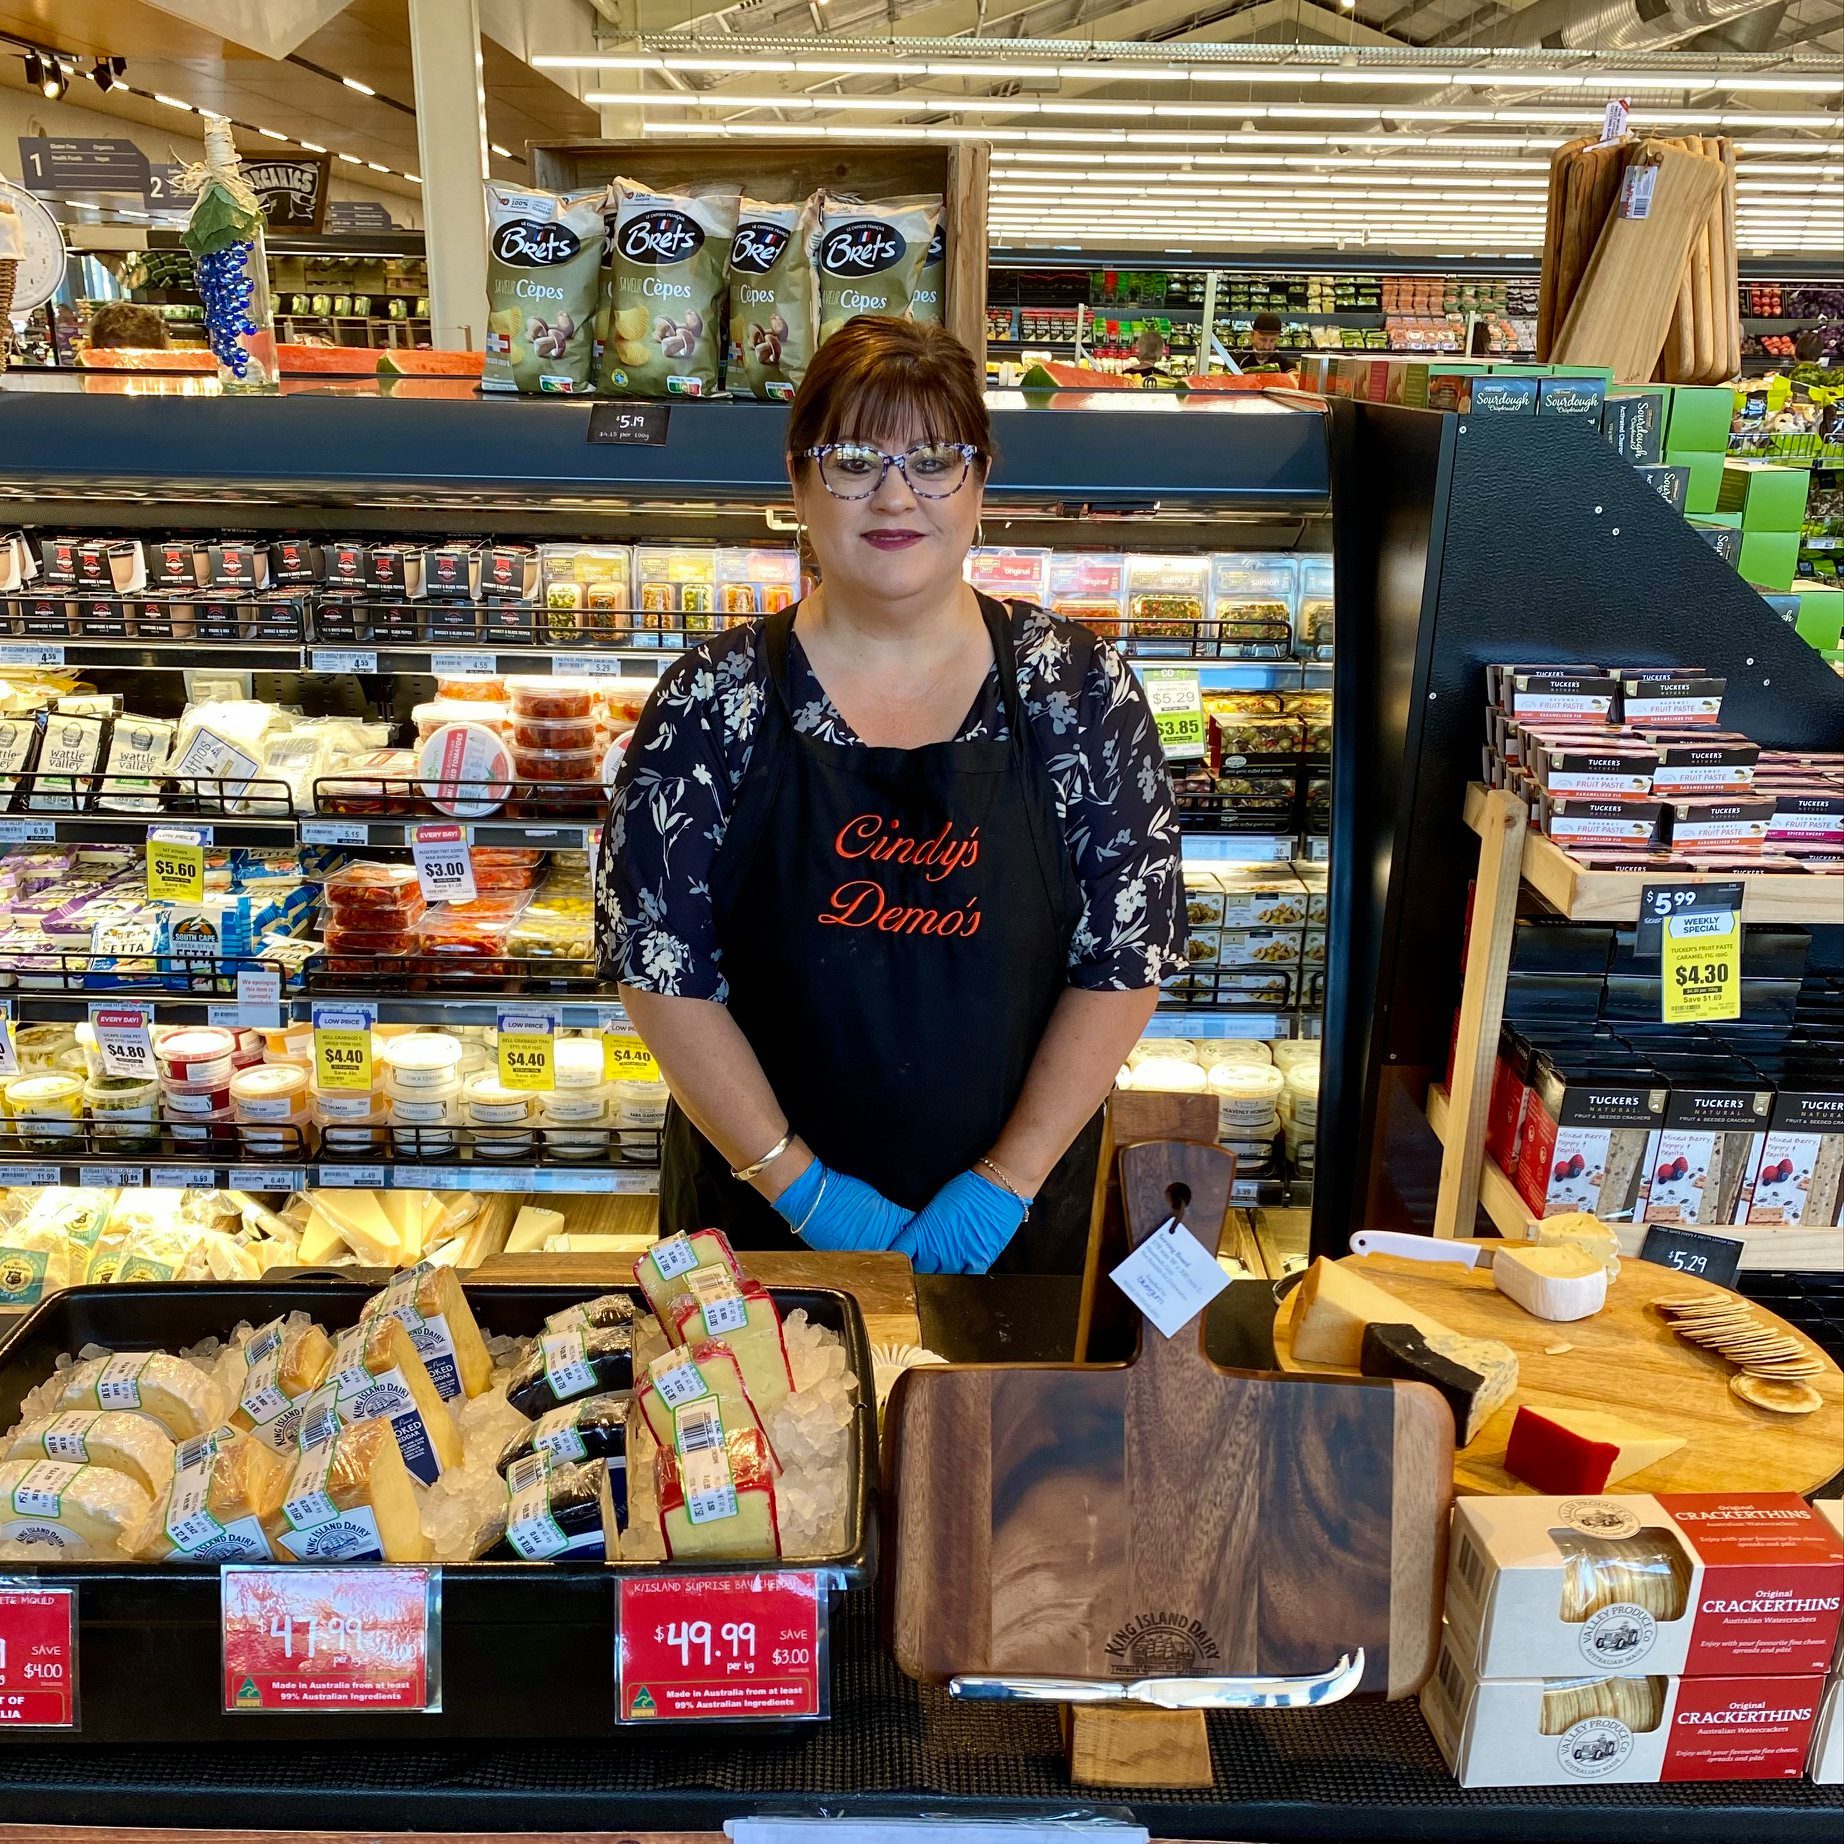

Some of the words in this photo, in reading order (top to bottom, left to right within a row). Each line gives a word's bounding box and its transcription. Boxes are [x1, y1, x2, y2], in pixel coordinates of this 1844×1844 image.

[29, 152, 42, 177] 1
[150, 177, 164, 198] 2
[625, 220, 696, 258] Brets
[500, 226, 572, 266] Brets
[826, 233, 896, 270] Brets
[516, 279, 564, 302] Cèpes
[642, 274, 691, 300] Cèpes
[740, 284, 775, 307] Cèpes
[840, 289, 887, 312] Cèpes
[1476, 392, 1529, 410] Sourdough
[1545, 393, 1599, 411] Sourdough
[616, 415, 644, 428] $5.19
[1635, 403, 1648, 458] Sourdough
[1004, 567, 1030, 577] original
[1083, 577, 1109, 587] original
[1161, 576, 1190, 585] salmon
[1250, 578, 1280, 586] salmon
[473, 661, 488, 670] 4.55
[595, 663, 611, 672] 5.29
[1153, 692, 1194, 705] $5.29
[1157, 720, 1199, 736] $3.85
[50, 750, 85, 762] wattle
[120, 752, 156, 764] wattle
[48, 759, 82, 772] valley
[118, 761, 153, 772] valley
[1576, 780, 1601, 788] FRUIT
[1601, 781, 1625, 789] PASTE
[1590, 804, 1622, 812] TUCKER'S
[1710, 807, 1741, 815] TUCKER'S
[33, 827, 48, 835] 6.99
[344, 830, 360, 839] 5.15
[835, 814, 980, 882] Cindy's
[155, 860, 196, 877] $5.60
[425, 862, 464, 877] $3.00
[818, 880, 981, 937] Demo's
[1684, 916, 1720, 926] WEEKLY
[1683, 924, 1720, 934] SPECIAL
[176, 934, 198, 942] SOUTH
[200, 933, 217, 942] CAPE
[1671, 946, 1698, 954] TUCKER'S
[1715, 943, 1734, 951] PASTE
[1676, 953, 1704, 961] CARAMEL
[1675, 963, 1728, 987] $4.30
[1683, 995, 1701, 1003] Save
[1702, 994, 1722, 1002] $1.69
[107, 1043, 145, 1058] $4.80
[325, 1048, 363, 1063] $4.40
[613, 1049, 651, 1063] $4.40
[508, 1052, 545, 1066] $4.40
[1589, 1096, 1639, 1106] TUCKER'S
[1694, 1099, 1744, 1108] TUCKER'S
[1664, 1134, 1686, 1143] Mixed
[270, 1177, 286, 1185] 6.49
[1675, 1510, 1812, 1520] CRACKERTHINS
[311, 1521, 343, 1541] ISLAND
[345, 1522, 371, 1537] DAIRY
[1755, 1589, 1793, 1599] Original
[21, 1597, 55, 1606] MOULD
[1702, 1597, 1840, 1613] CRACKERTHINS
[1583, 1610, 1609, 1644] VALLEY
[1612, 1606, 1653, 1628] PRODUCE
[1722, 1617, 1763, 1625] Australian
[1763, 1616, 1817, 1624] Watercrackers
[780, 1630, 808, 1640] SAVE
[1104, 1623, 1137, 1658] KING
[1134, 1612, 1189, 1630] ISLAND
[1189, 1620, 1220, 1660] DAIRY
[654, 1620, 756, 1667] $49.99
[1700, 1640, 1721, 1648] Enjoy
[1755, 1639, 1789, 1647] favourite
[31, 1644, 62, 1656] SAVE
[772, 1649, 809, 1665] $3.00
[24, 1662, 62, 1678] $4.00
[727, 1661, 741, 1674] per
[744, 1661, 755, 1674] kg
[271, 1681, 297, 1689] Made
[298, 1681, 307, 1689] in
[309, 1681, 351, 1689] Australia
[352, 1681, 373, 1689] from
[375, 1682, 386, 1690] at
[386, 1681, 410, 1690] least
[280, 1692, 300, 1701] 99%
[302, 1692, 349, 1701] Australian
[350, 1692, 402, 1702] Ingredients
[666, 1689, 691, 1699] Made
[693, 1689, 701, 1698] in
[704, 1688, 744, 1697] Australia
[745, 1687, 767, 1696] from
[768, 1687, 779, 1695] at
[780, 1686, 803, 1695] least
[674, 1701, 694, 1710] 99%
[696, 1699, 742, 1709] Australian
[744, 1698, 794, 1708] Ingredients
[1729, 1701, 1766, 1711] Original
[1678, 1708, 1812, 1724] CRACKERTHINS
